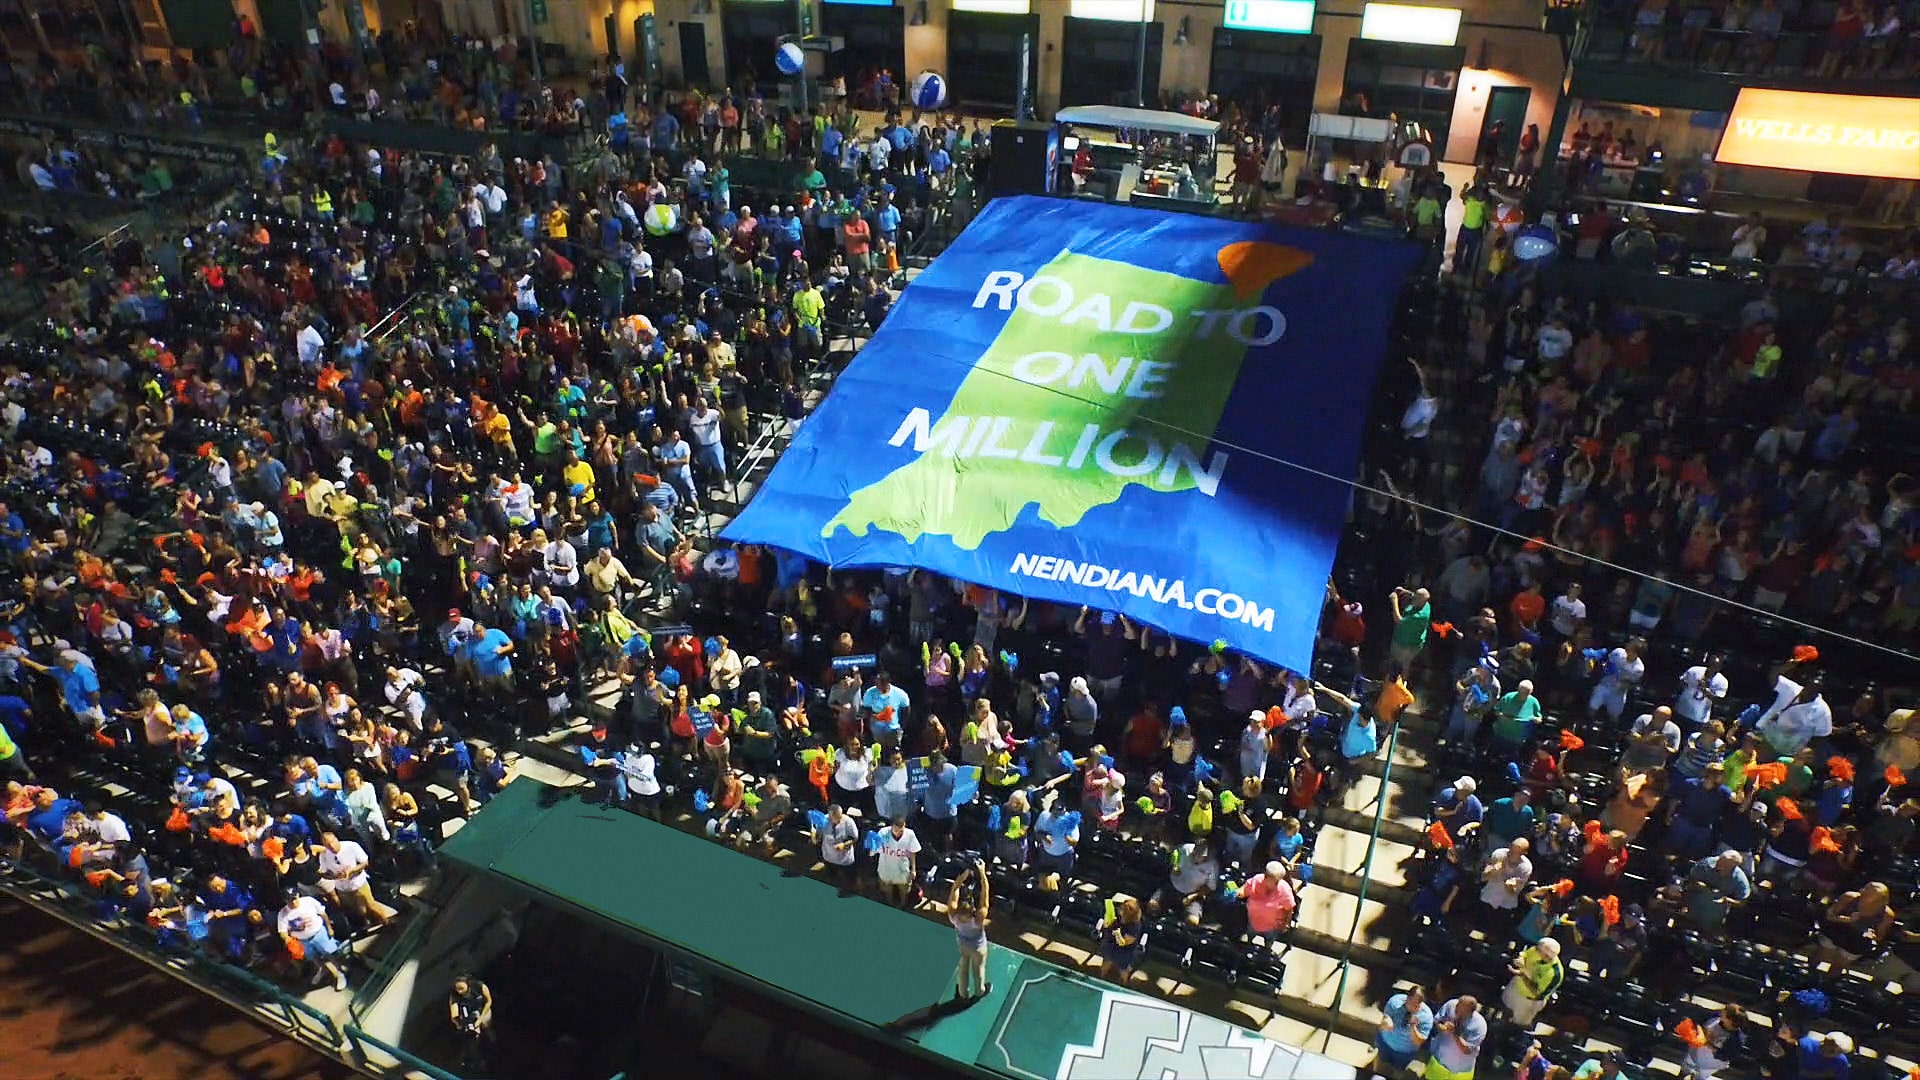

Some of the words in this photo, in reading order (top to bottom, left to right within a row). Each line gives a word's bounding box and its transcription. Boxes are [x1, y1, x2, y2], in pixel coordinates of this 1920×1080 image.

[1735, 118, 1833, 145] WELLS
[972, 271, 1174, 333] ROAD
[1191, 305, 1286, 346] TO
[1012, 351, 1177, 399] ONE
[887, 407, 1228, 497] MILLION
[1010, 553, 1275, 631] NEINDIANA.COM
